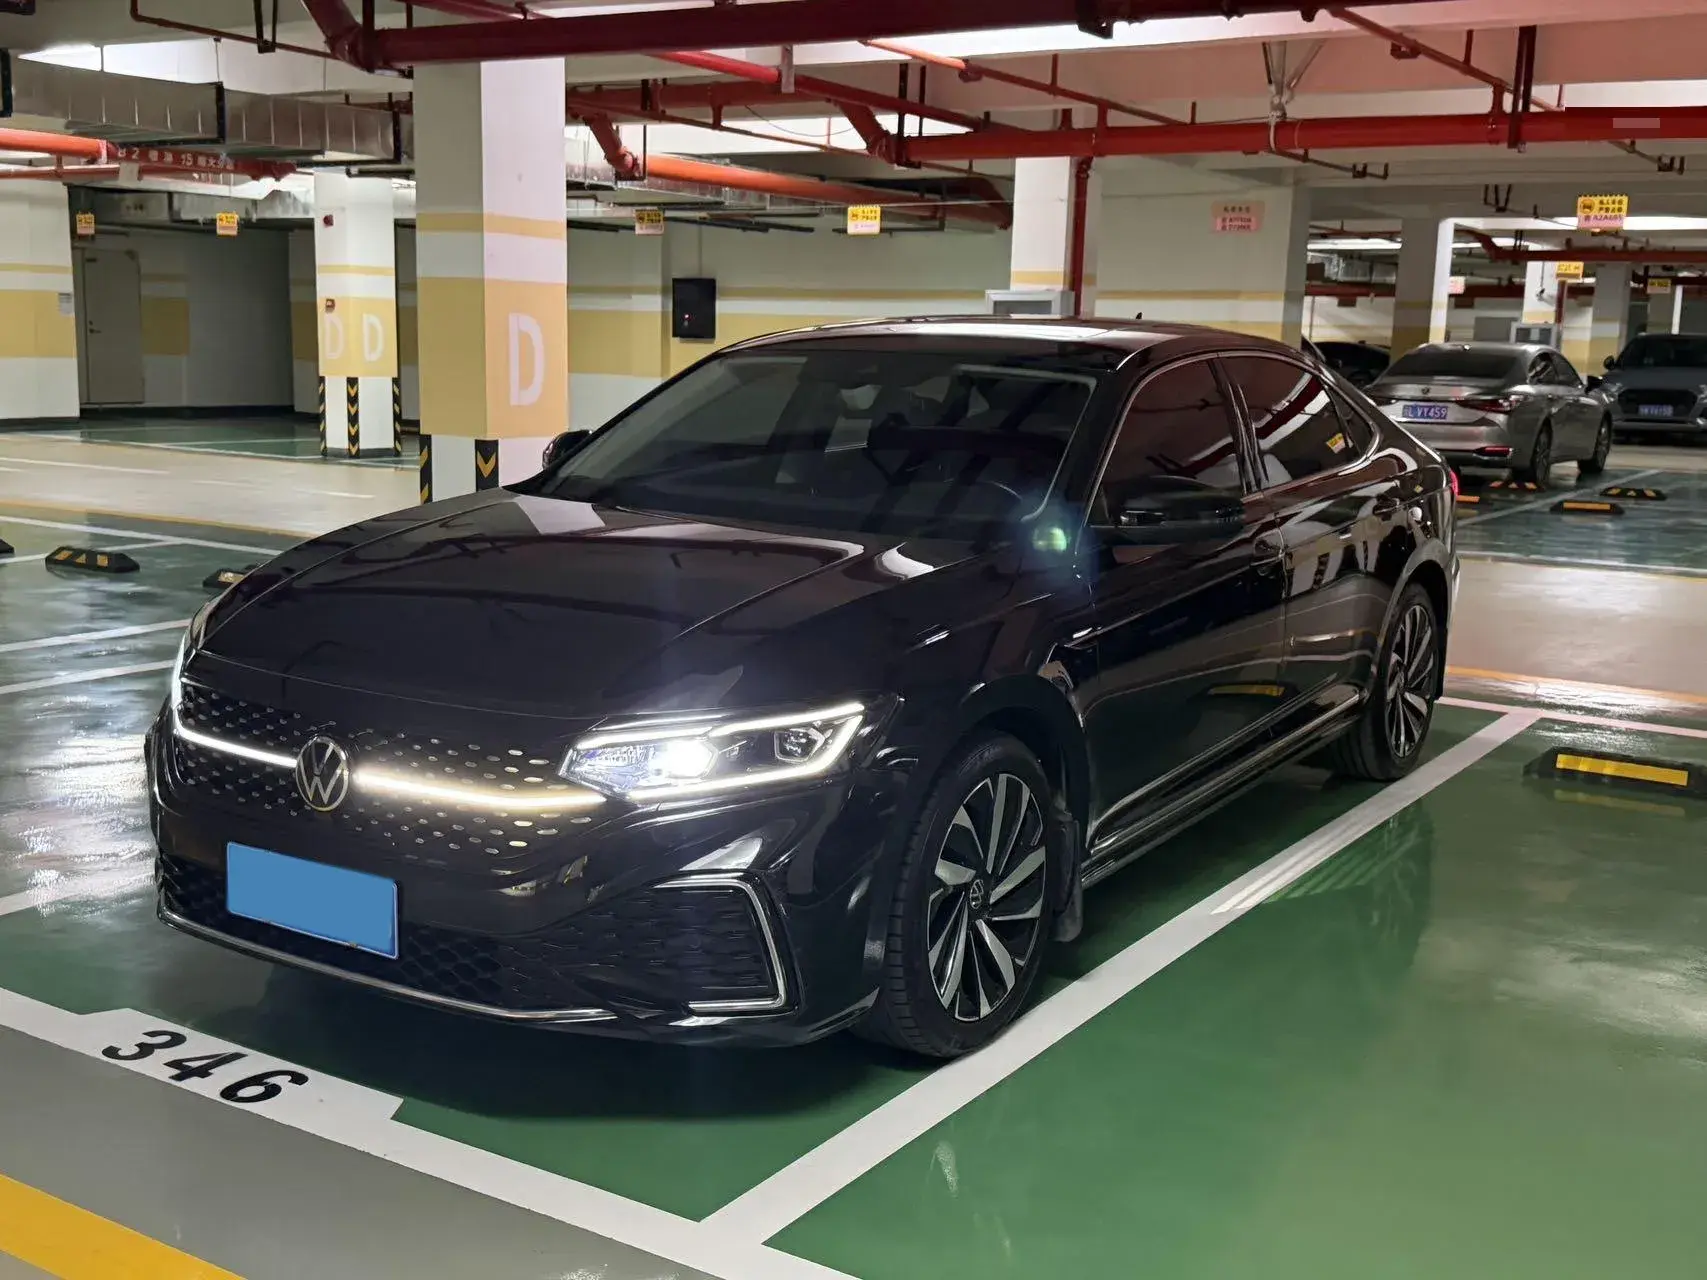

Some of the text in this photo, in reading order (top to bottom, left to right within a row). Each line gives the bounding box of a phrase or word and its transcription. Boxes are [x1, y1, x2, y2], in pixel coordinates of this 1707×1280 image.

[324, 313, 344, 360] D
[362, 312, 384, 362] D
[508, 312, 544, 406] D
[101, 1029, 309, 1103] 346
